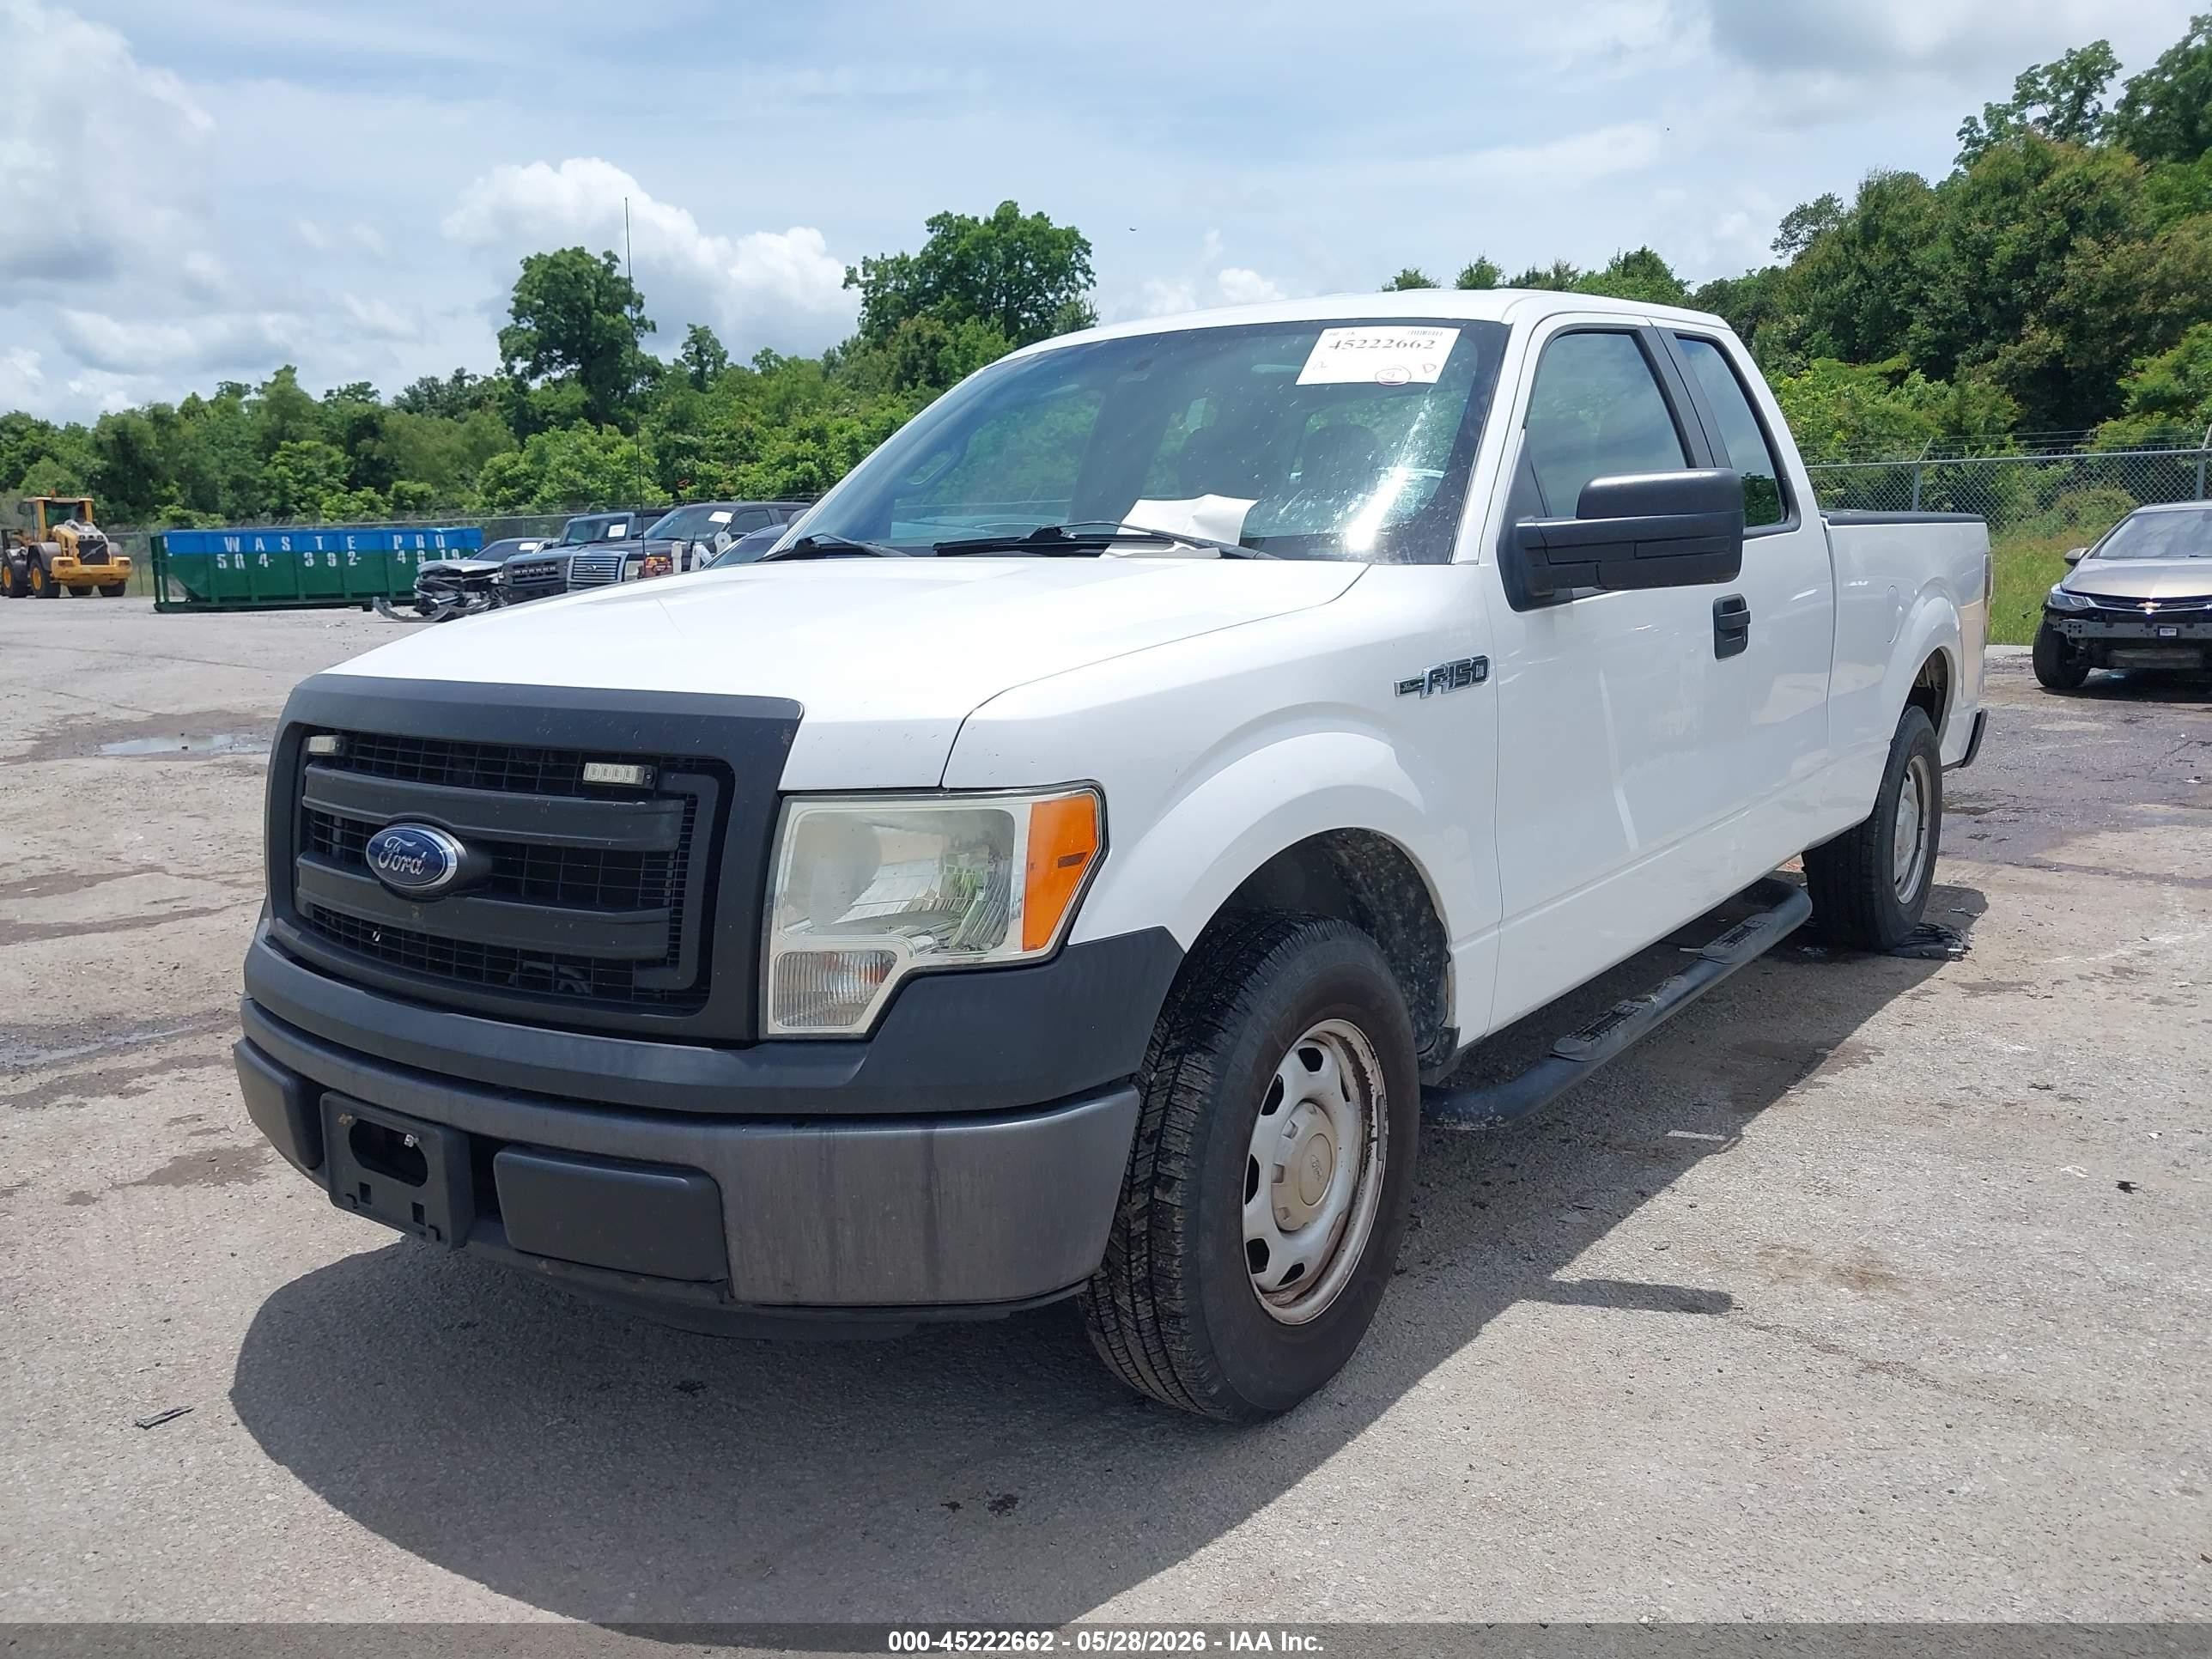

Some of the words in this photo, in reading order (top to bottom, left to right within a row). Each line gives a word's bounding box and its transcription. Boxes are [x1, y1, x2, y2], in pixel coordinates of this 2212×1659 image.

[1328, 338, 1437, 350] 45222662
[223, 536, 356, 552] WASTE
[392, 534, 446, 550] PRO
[379, 836, 427, 876] Ford
